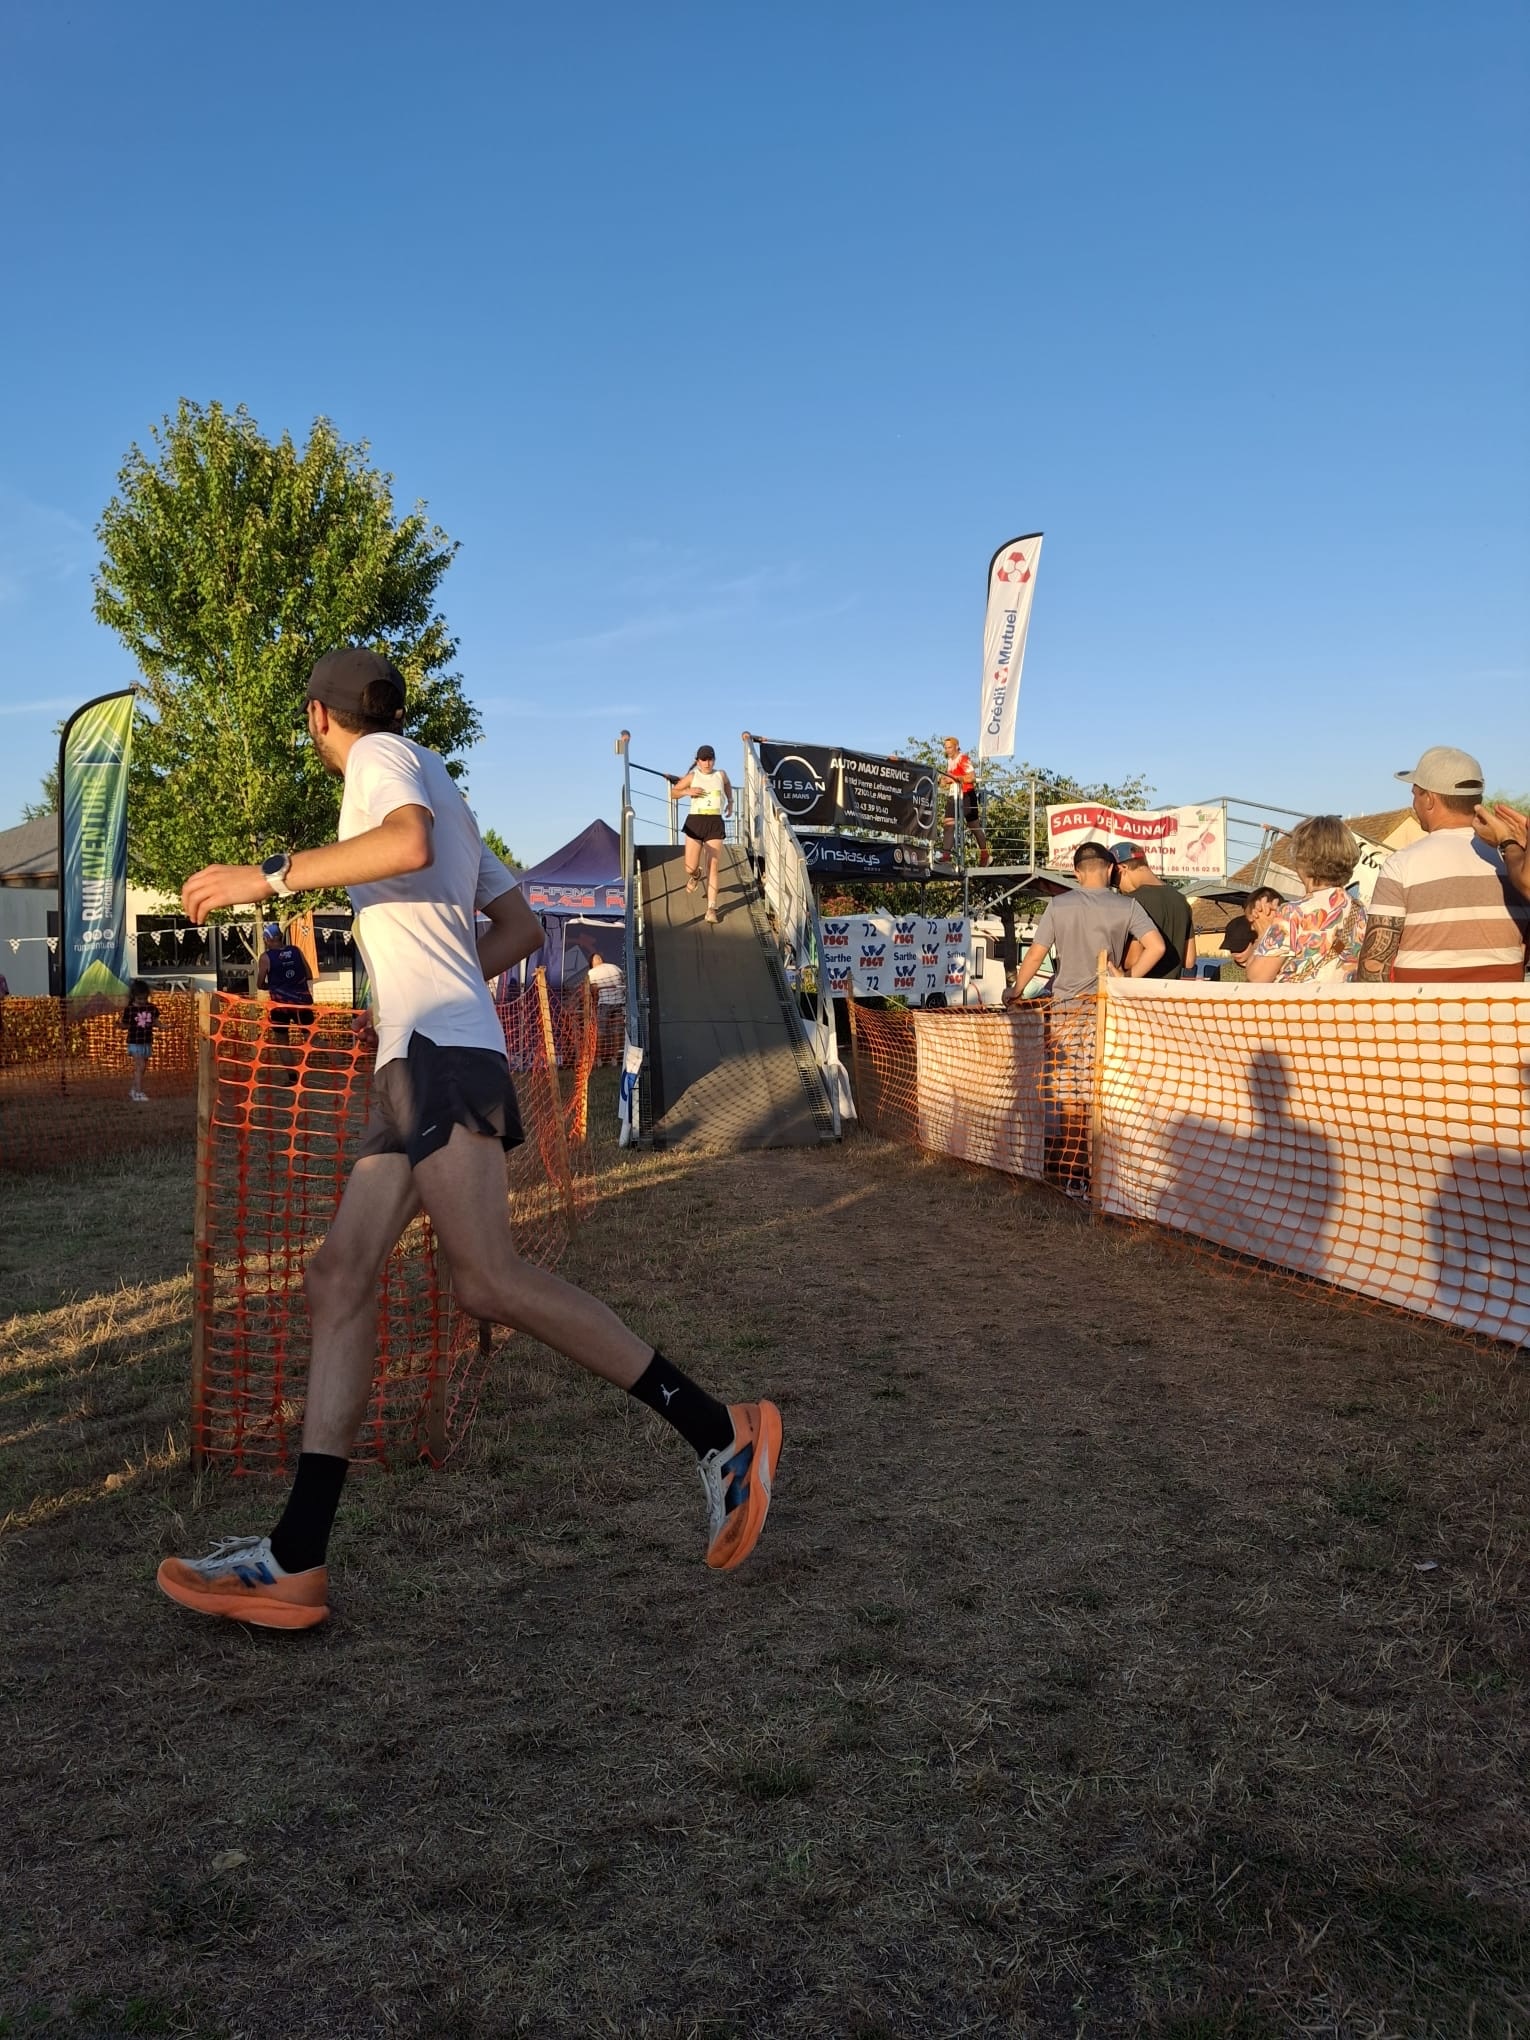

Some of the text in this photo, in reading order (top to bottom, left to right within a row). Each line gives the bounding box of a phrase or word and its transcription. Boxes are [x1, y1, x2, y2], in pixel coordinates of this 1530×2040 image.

[987, 610, 1017, 735] Crédit Mutuel
[830, 758, 910, 782] AUTO MAXI SERVICE
[1053, 813, 1167, 836] SARL DELAUNAY
[821, 848, 880, 866] Instasys
[530, 886, 595, 897] CHRONO
[862, 923, 877, 937] 72
[927, 921, 938, 935] 72
[825, 953, 852, 963] Sarthe
[894, 952, 917, 961] Sarthe
[830, 980, 848, 990] SGT
[867, 976, 880, 991] 72
[927, 973, 937, 988] 72
